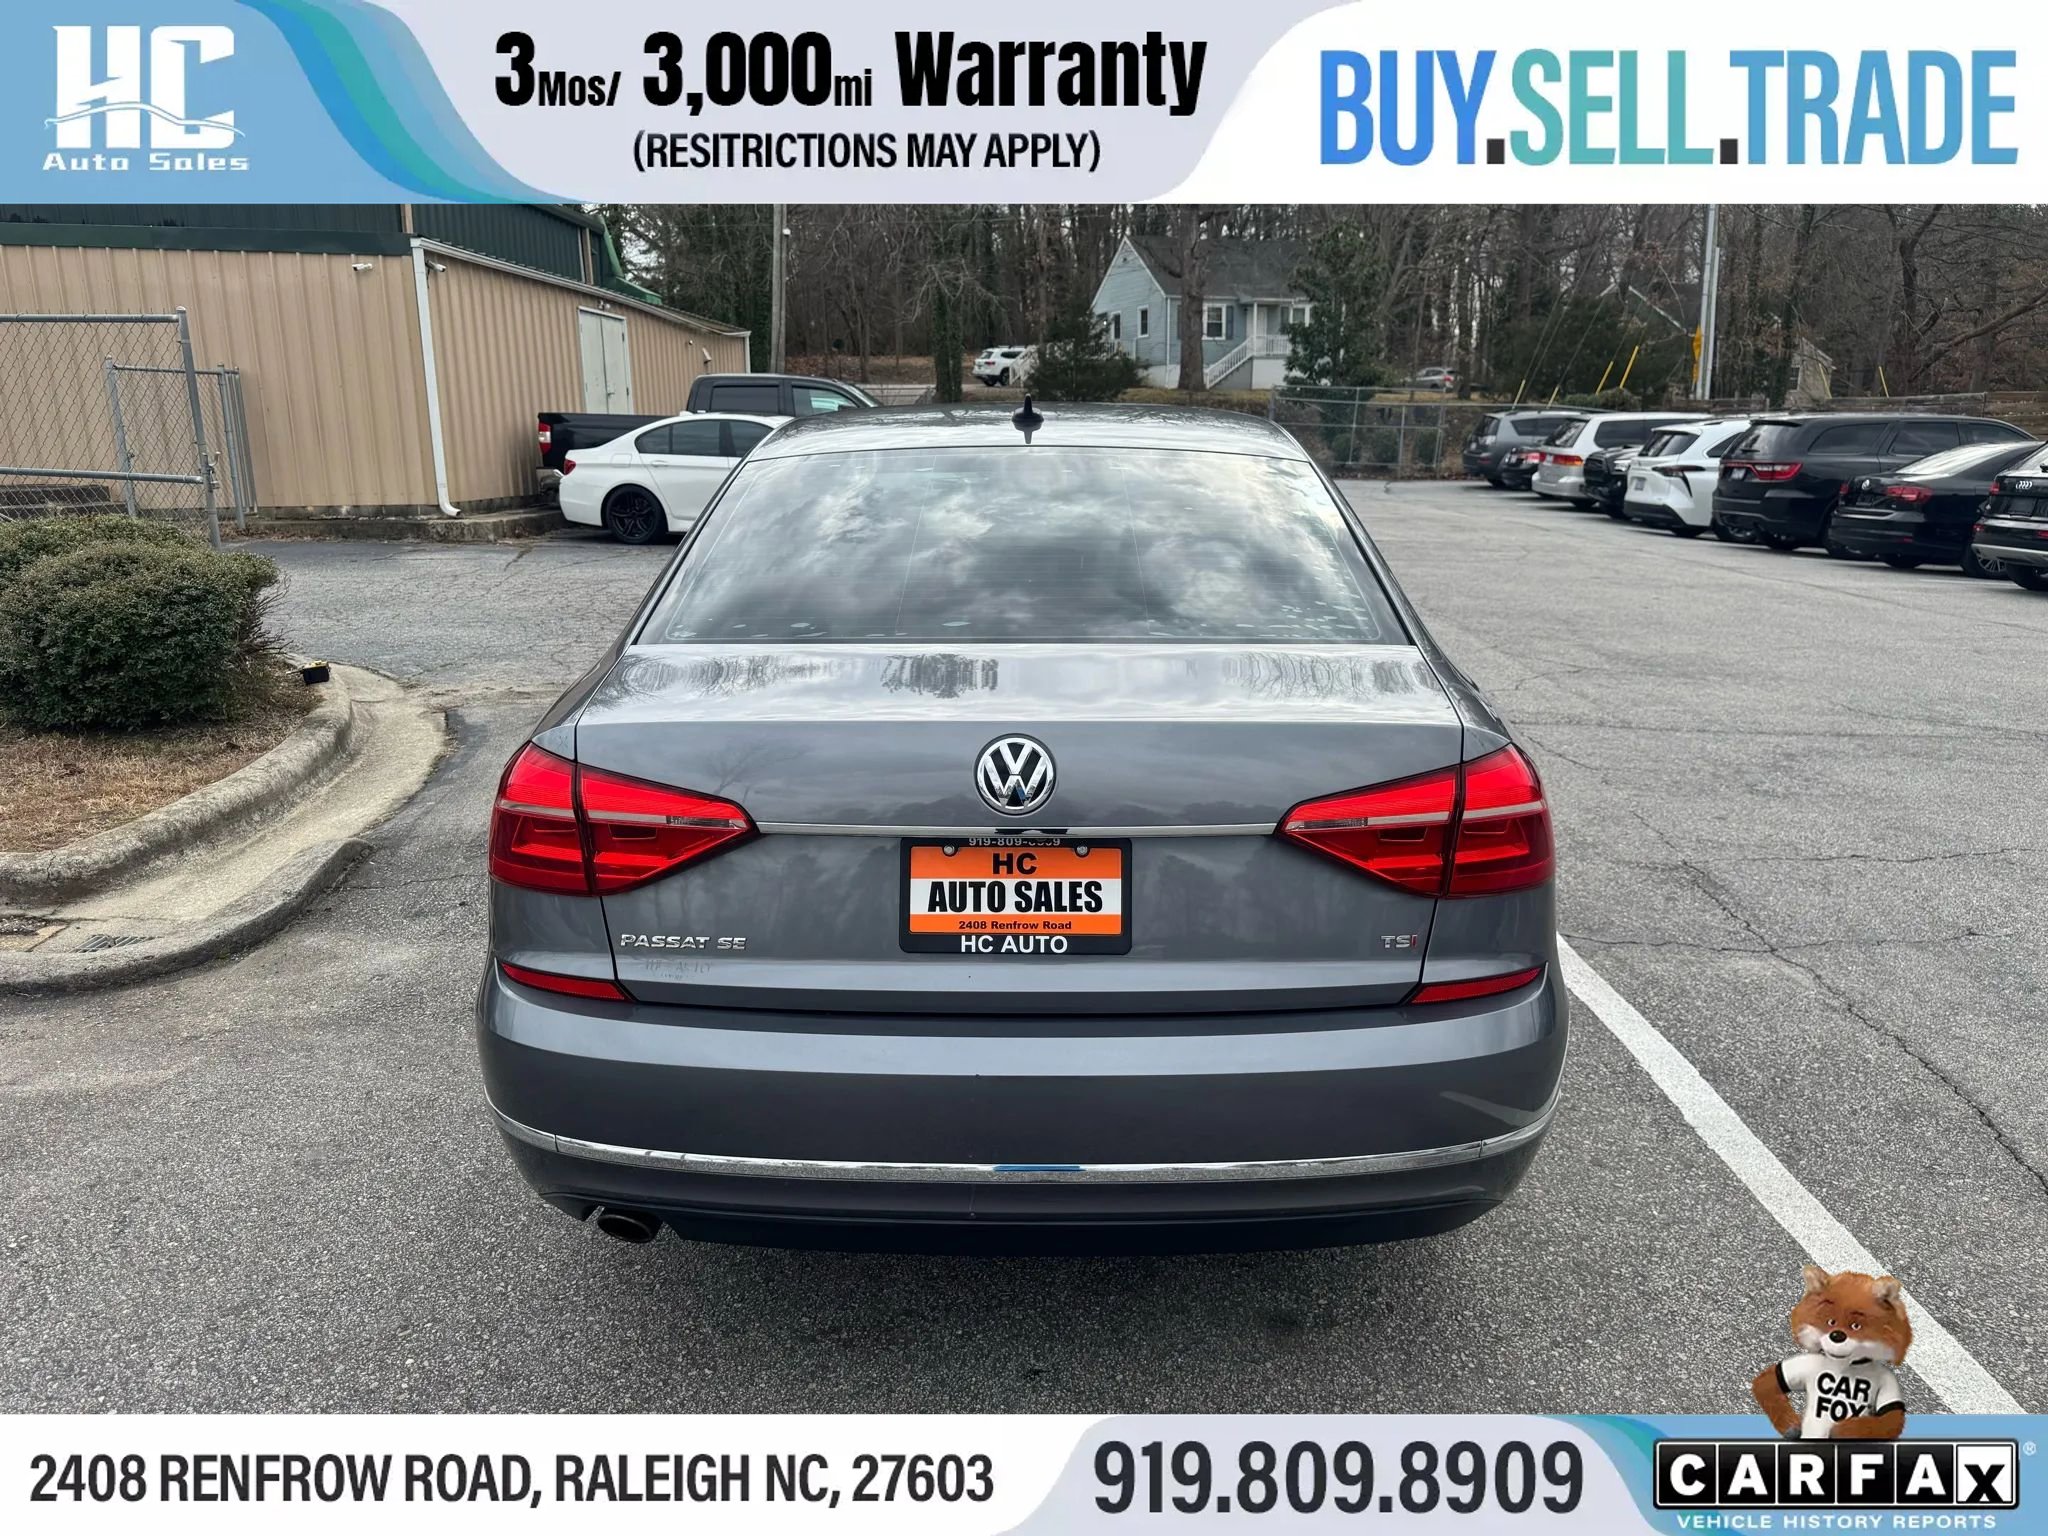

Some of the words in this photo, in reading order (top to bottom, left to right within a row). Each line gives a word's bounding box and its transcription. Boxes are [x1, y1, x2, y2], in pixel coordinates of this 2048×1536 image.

[992, 853, 1037, 874] HC
[927, 880, 1006, 913] AUTO
[1014, 880, 1103, 913] SALES
[959, 920, 987, 930] 2408
[991, 920, 1039, 930] Renfrow
[1043, 920, 1072, 930] Road
[620, 934, 710, 949] PASSAT
[717, 937, 747, 950] SE
[961, 935, 994, 953] HC
[1000, 935, 1068, 954] AUTO
